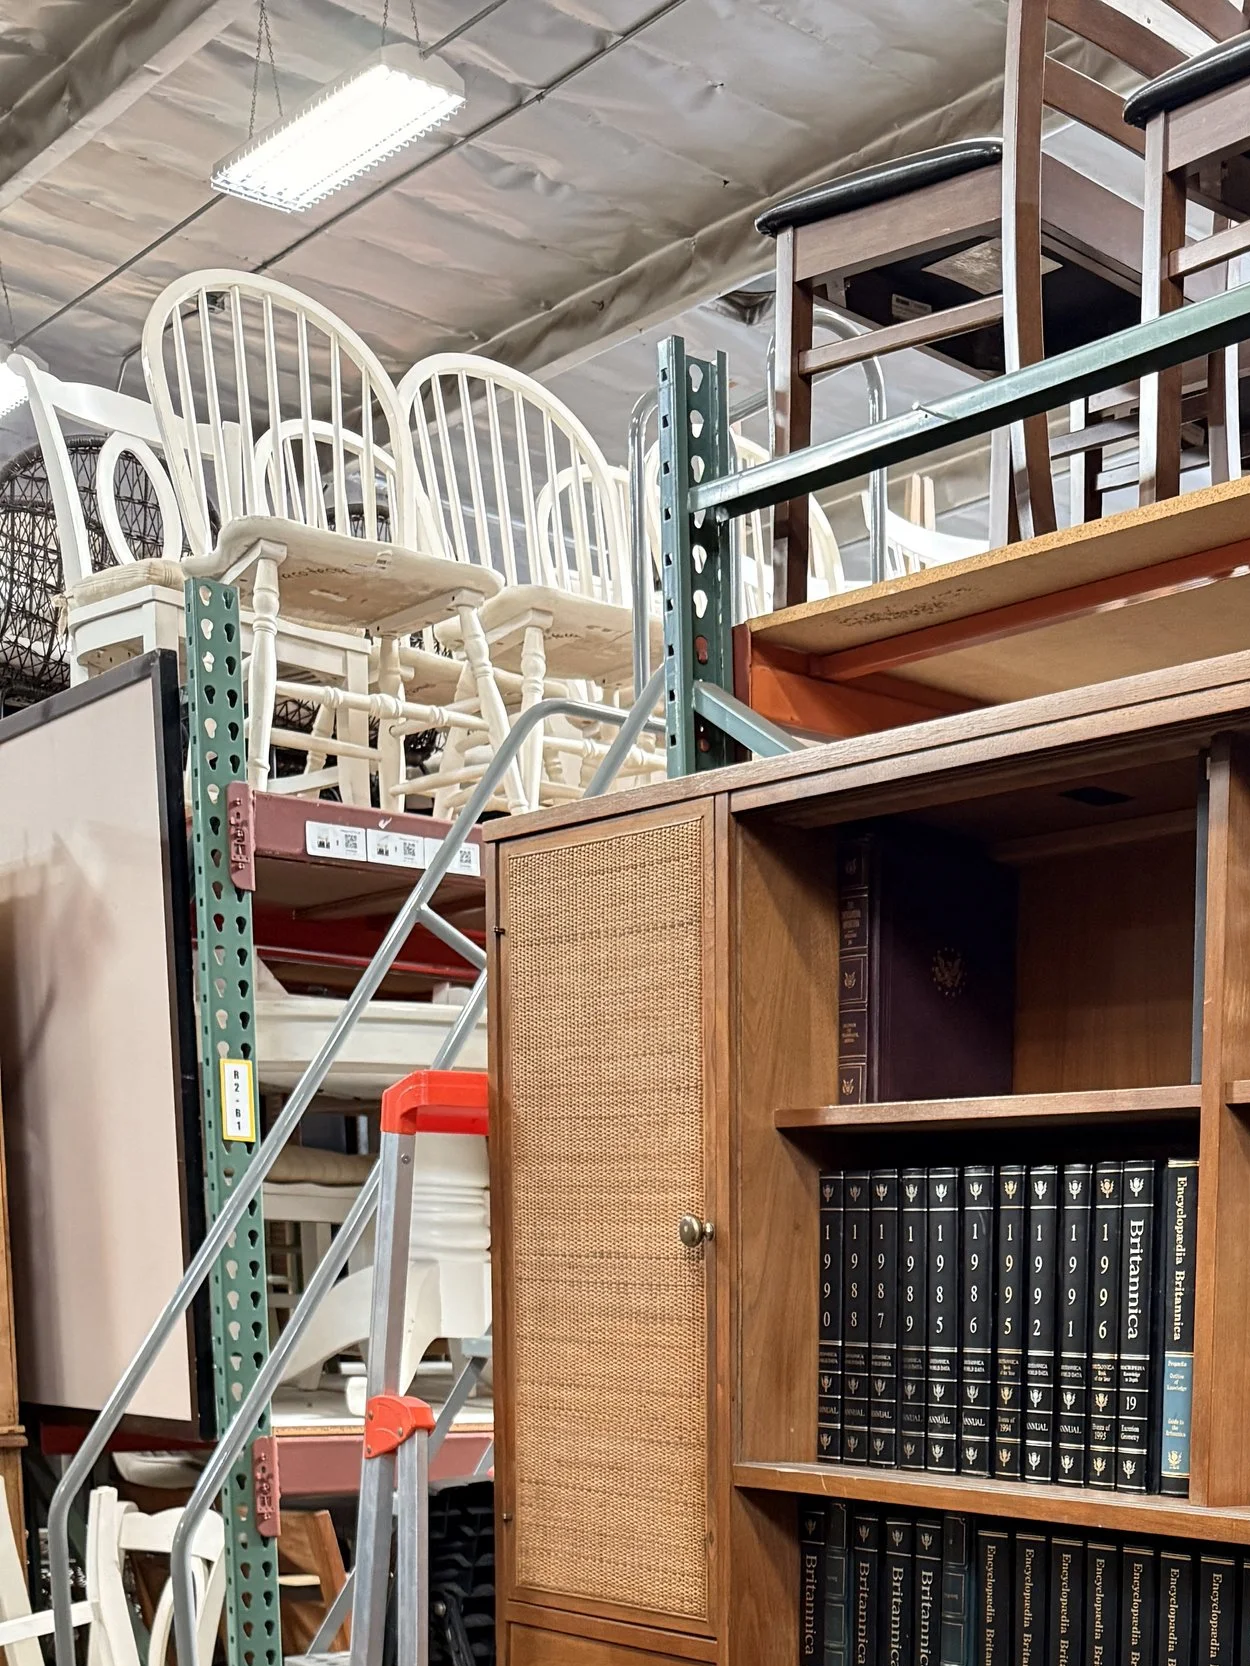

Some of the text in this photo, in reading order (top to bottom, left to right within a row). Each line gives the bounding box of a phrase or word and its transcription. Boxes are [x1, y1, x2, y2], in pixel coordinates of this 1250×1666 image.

[906, 1226, 914, 1332] 1989
[936, 1224, 944, 1333] 1985
[969, 1223, 979, 1333] 1986
[1004, 1224, 1013, 1335] 1995
[1033, 1224, 1043, 1336] 1992
[1067, 1224, 1078, 1337] 1991
[1098, 1223, 1109, 1338] 1996
[1127, 1219, 1144, 1340] Britannica
[1173, 1270, 1186, 1341] Britannica
[1125, 1396, 1137, 1410] 19
[805, 1555, 817, 1655] Britannica
[857, 1562, 870, 1665] Britannica
